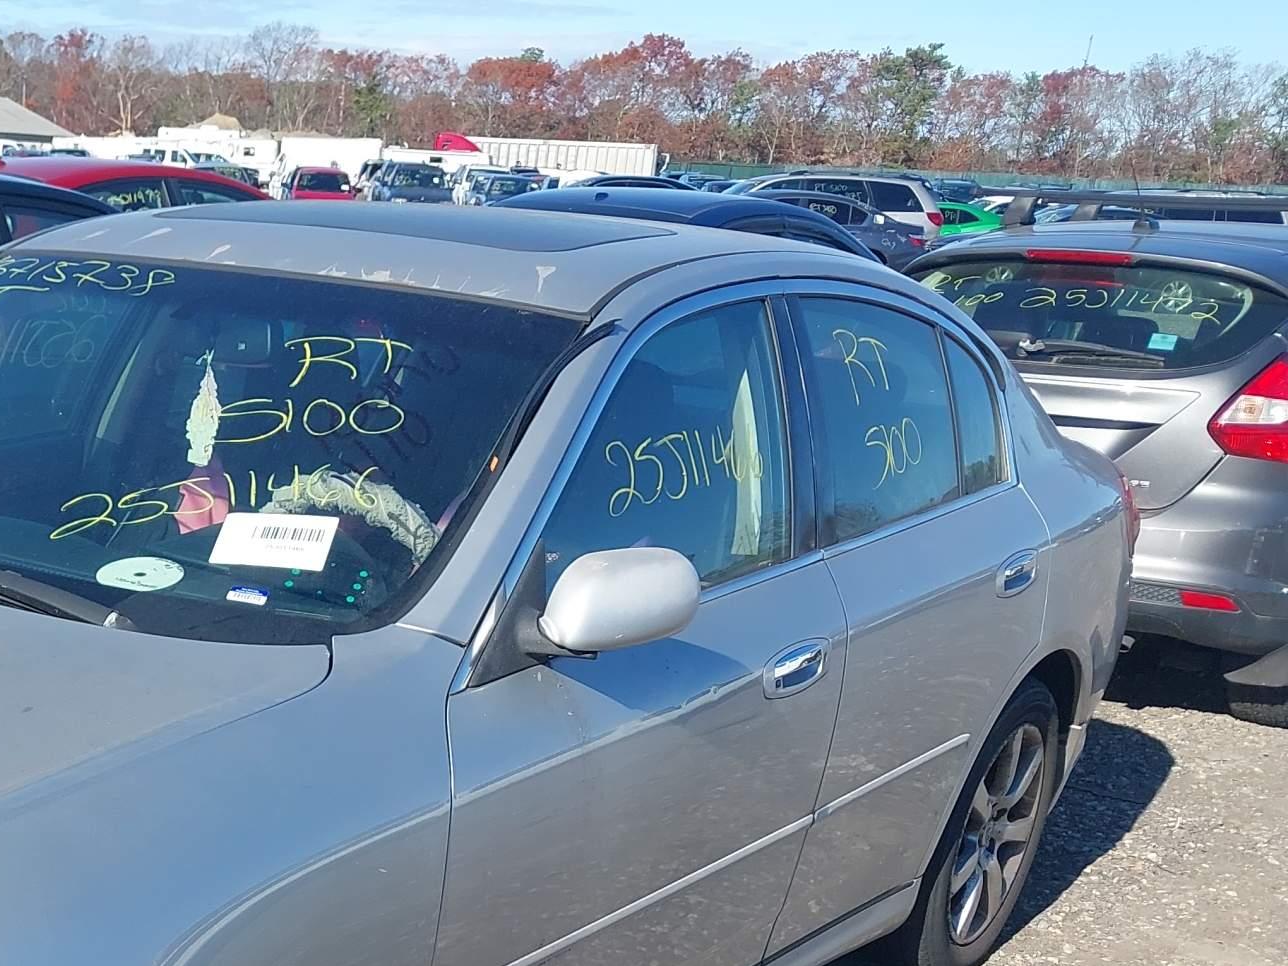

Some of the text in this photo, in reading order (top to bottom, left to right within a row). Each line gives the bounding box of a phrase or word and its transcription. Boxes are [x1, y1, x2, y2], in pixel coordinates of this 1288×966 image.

[284, 335, 415, 388] RT
[832, 328, 888, 407] RT
[215, 398, 406, 444] 5100
[864, 416, 923, 491] 5100
